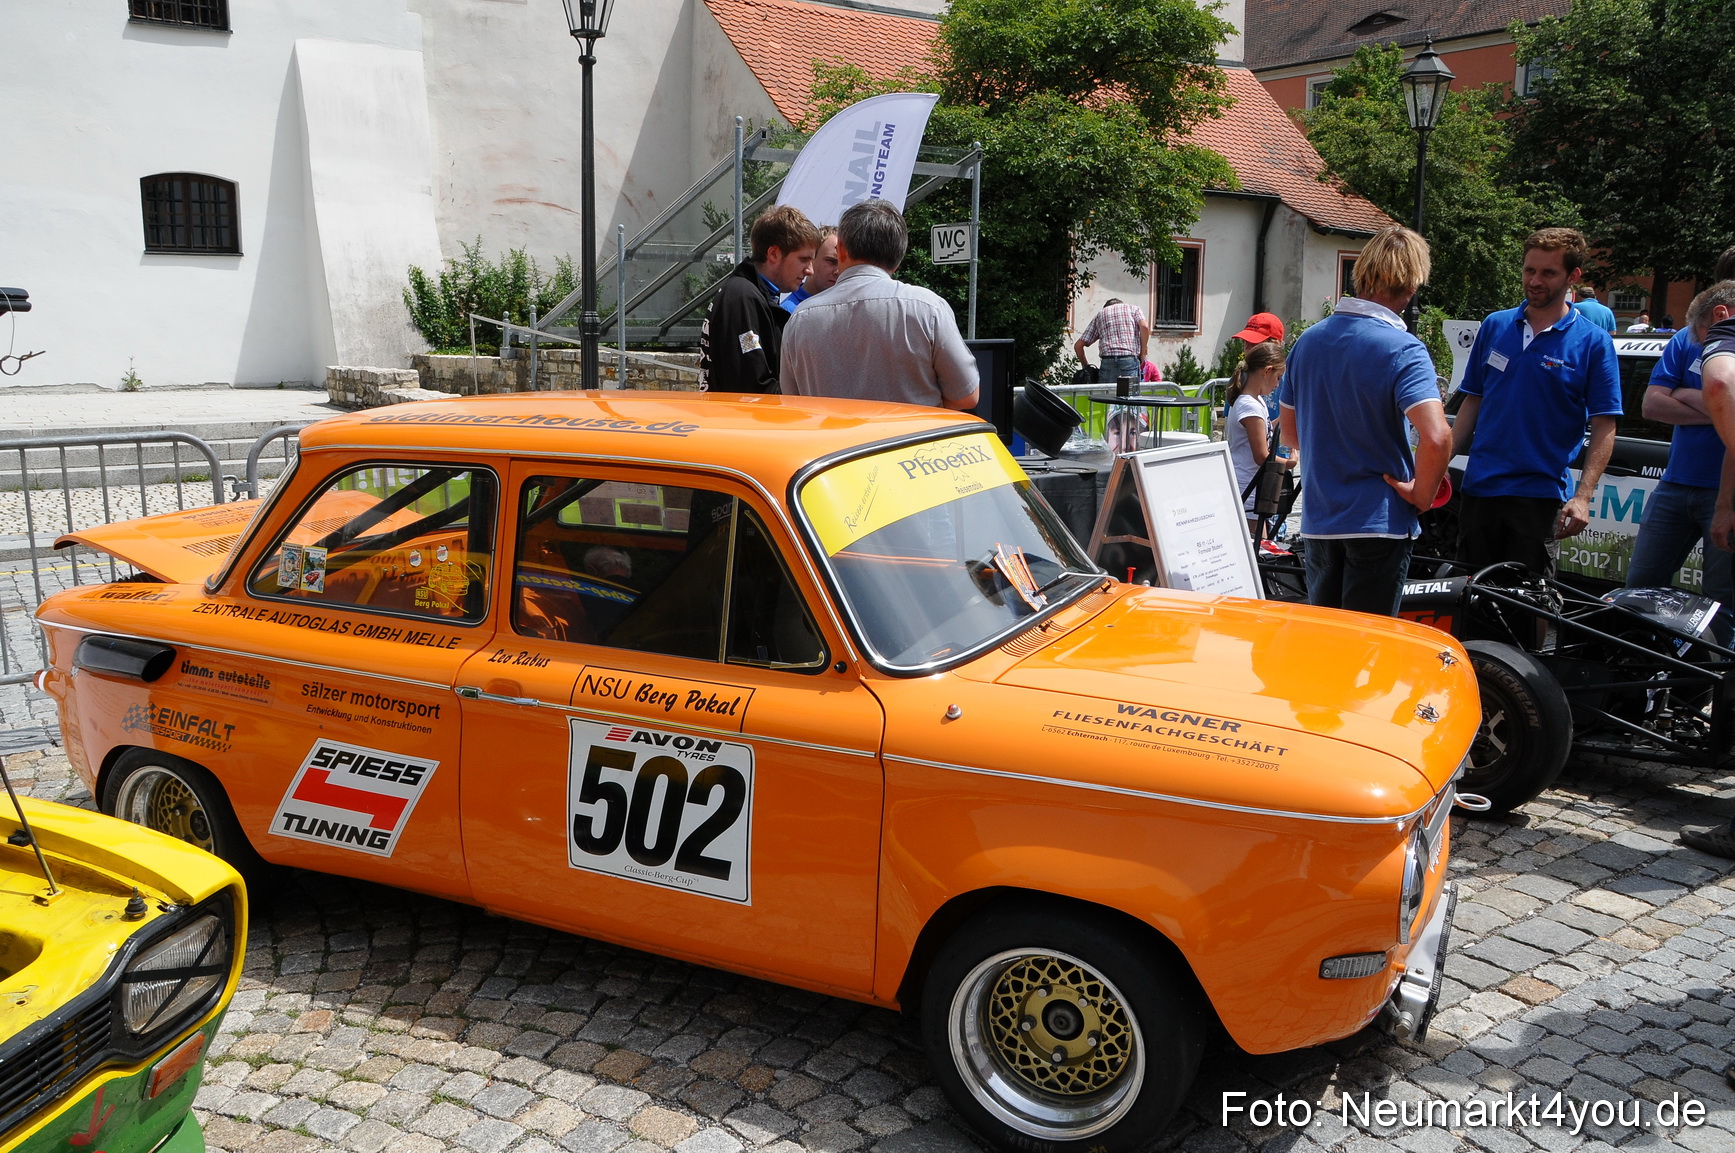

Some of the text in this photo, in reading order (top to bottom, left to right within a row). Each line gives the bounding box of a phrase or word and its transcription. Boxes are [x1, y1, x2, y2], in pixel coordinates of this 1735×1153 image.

[839, 121, 881, 210] NAIL
[937, 229, 966, 249] WC
[370, 412, 700, 433] oldtimer-house.de
[844, 504, 864, 534] Reisen
[415, 600, 450, 609] Berg Pokal
[192, 602, 461, 650] ZENTRALE AUTOGLAS GMBH MELLE
[181, 660, 271, 689] timms autoteile
[488, 649, 551, 668] Leo Rabus
[301, 681, 441, 719] sälzer motorsport
[580, 674, 742, 716] NSU Berg Pokal
[1481, 662, 1540, 728] MICHELIN
[157, 707, 236, 742] EINFALT
[306, 704, 433, 735] Entwicklung und Konstruktionen
[1052, 709, 1288, 757] FLIESENFACHGESCHÄFT
[1117, 703, 1242, 733] WAGNER
[630, 730, 723, 754] AVON
[676, 750, 717, 762] TYRES
[1066, 730, 1109, 742] Echternach
[1129, 740, 1151, 749] route
[1151, 742, 1162, 751] de
[1162, 745, 1211, 760] Luxembourg
[1216, 754, 1229, 763] Tel.
[310, 746, 427, 786] SPIESS
[573, 744, 747, 882] 502
[282, 812, 392, 850] TUNING
